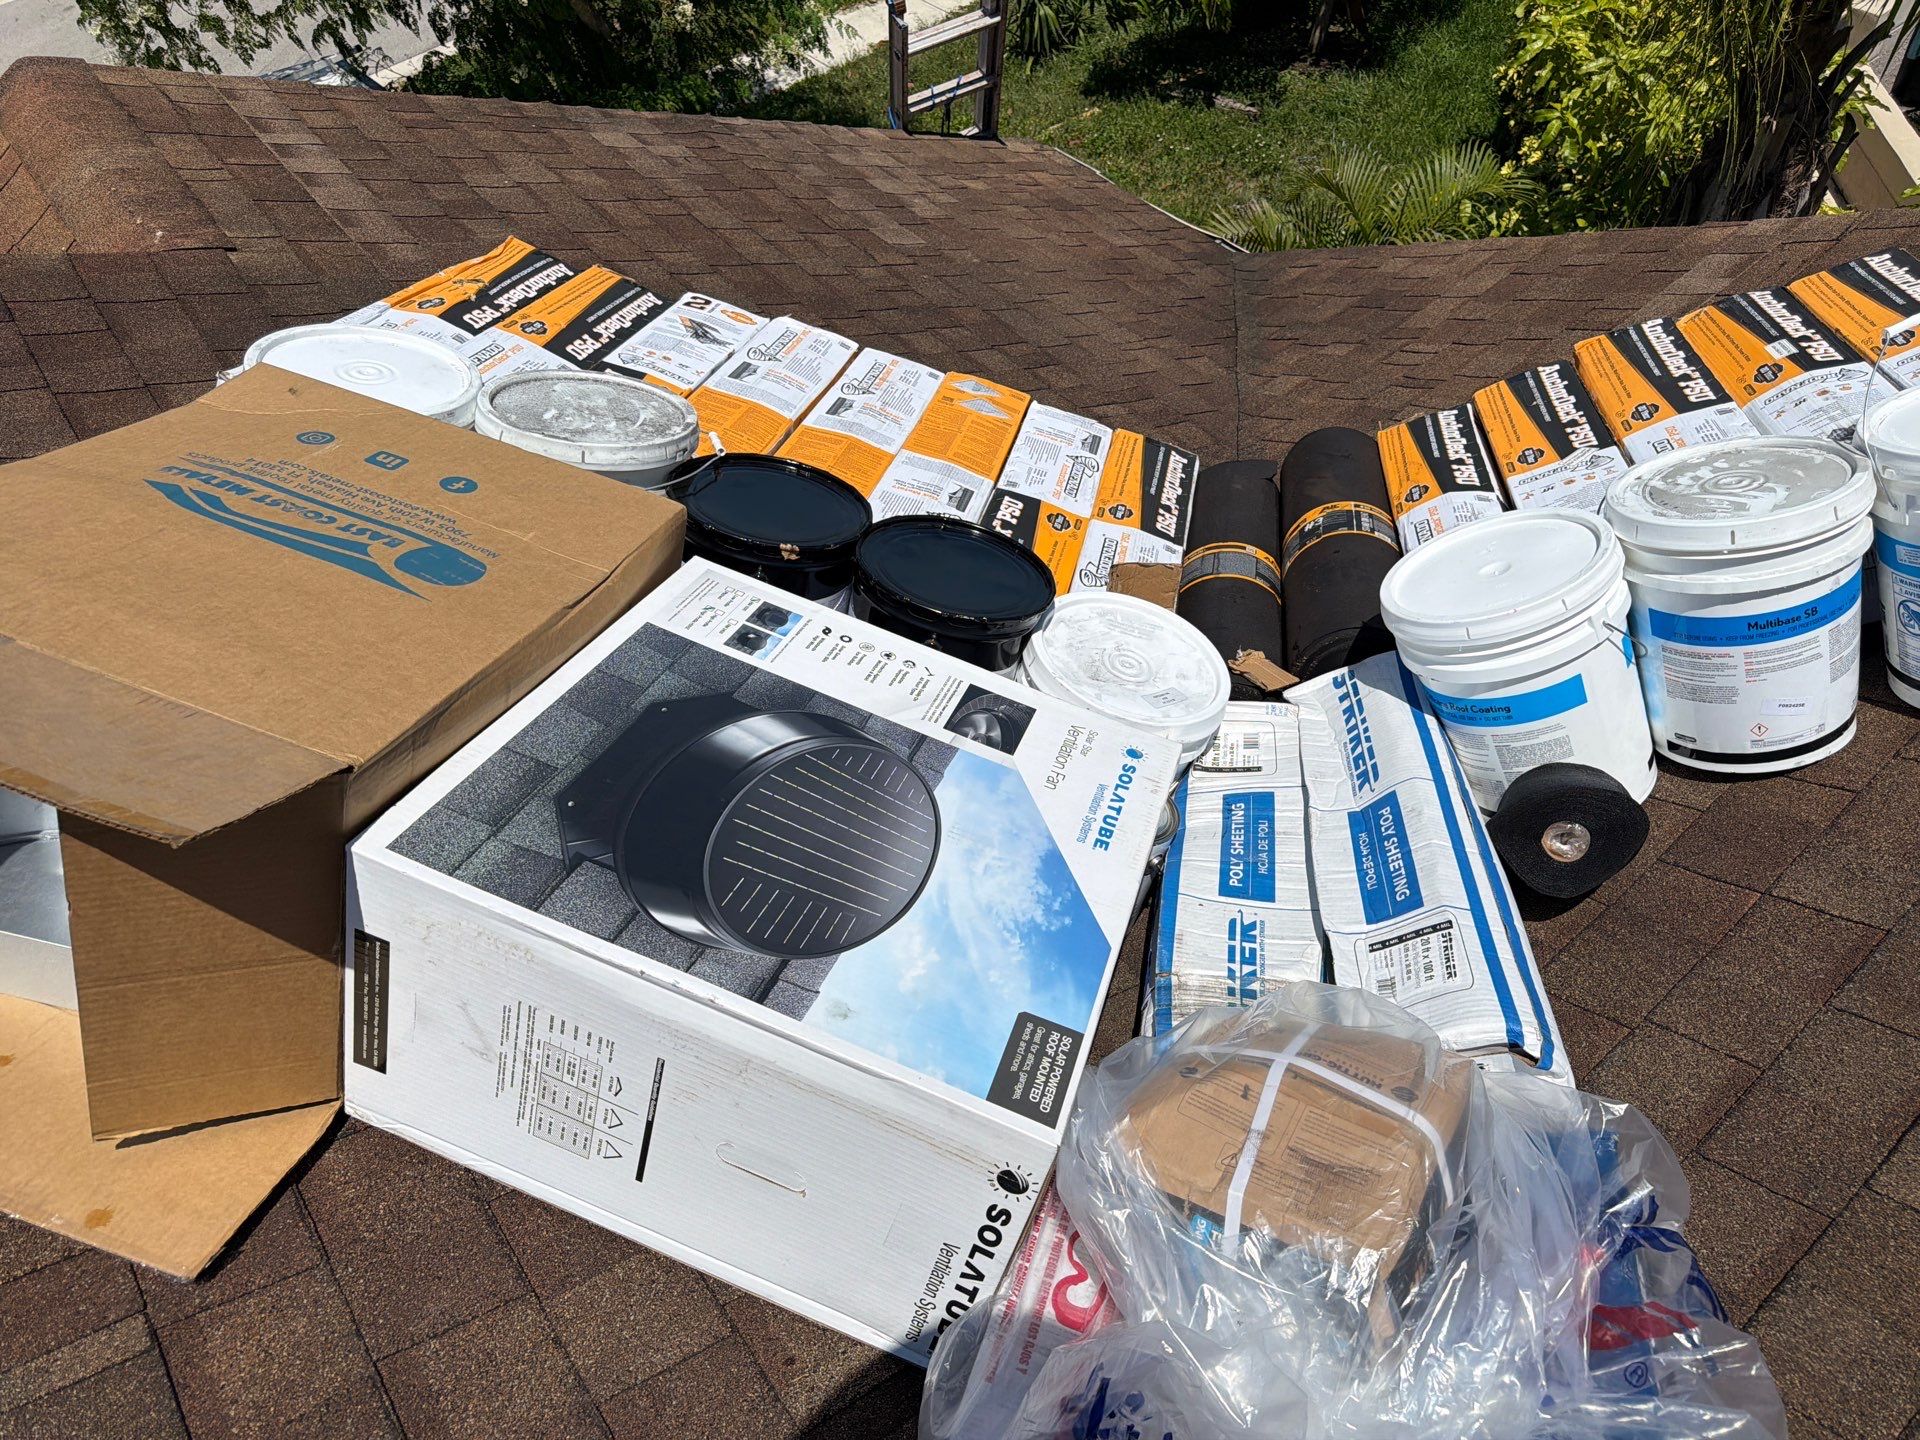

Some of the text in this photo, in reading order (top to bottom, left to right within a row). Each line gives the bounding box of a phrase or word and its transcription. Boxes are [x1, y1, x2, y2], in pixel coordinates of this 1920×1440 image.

[463, 302, 498, 330] PSU
[565, 331, 601, 362] PSU
[1799, 336, 1844, 365] PSU
[1677, 375, 1716, 405] PSU
[1564, 422, 1598, 449] PSU
[1450, 463, 1480, 485] PSU
[293, 480, 335, 503] metal
[360, 493, 385, 509] Ave
[337, 494, 385, 519] quality
[341, 521, 405, 549] EAST
[1154, 507, 1177, 536] PSU
[400, 516, 498, 559] Manufacturers
[1747, 606, 1819, 631] Multibase SB
[1755, 630, 1779, 640] FREEZING
[1450, 703, 1511, 714] Roof Coating
[1079, 729, 1098, 757] Solar Star
[1331, 669, 1379, 794] STRIKER
[1043, 723, 1086, 791] Ventilation Fan
[1073, 783, 1109, 844] Ventilation Systems
[1092, 762, 1137, 852] SOLATUBE
[1229, 802, 1245, 887] POLY SHEETING
[1258, 820, 1268, 840] POLI
[1258, 855, 1268, 874] HOJA
[1359, 832, 1369, 854] HOJA
[1366, 866, 1378, 890] POLI
[1378, 806, 1410, 902] POLY SHEETING
[1420, 936, 1430, 946] 20
[1441, 931, 1457, 979] STRIKER
[1422, 960, 1433, 974] 100
[1010, 1021, 1034, 1072] sheds and more.
[1011, 1025, 1046, 1100] Great for attics, garages,
[1028, 1030, 1060, 1102] ROOF MOUNTED
[1038, 1035, 1072, 1113] SOLAR POWERED
[903, 1242, 960, 1342] Ventilation Systems
